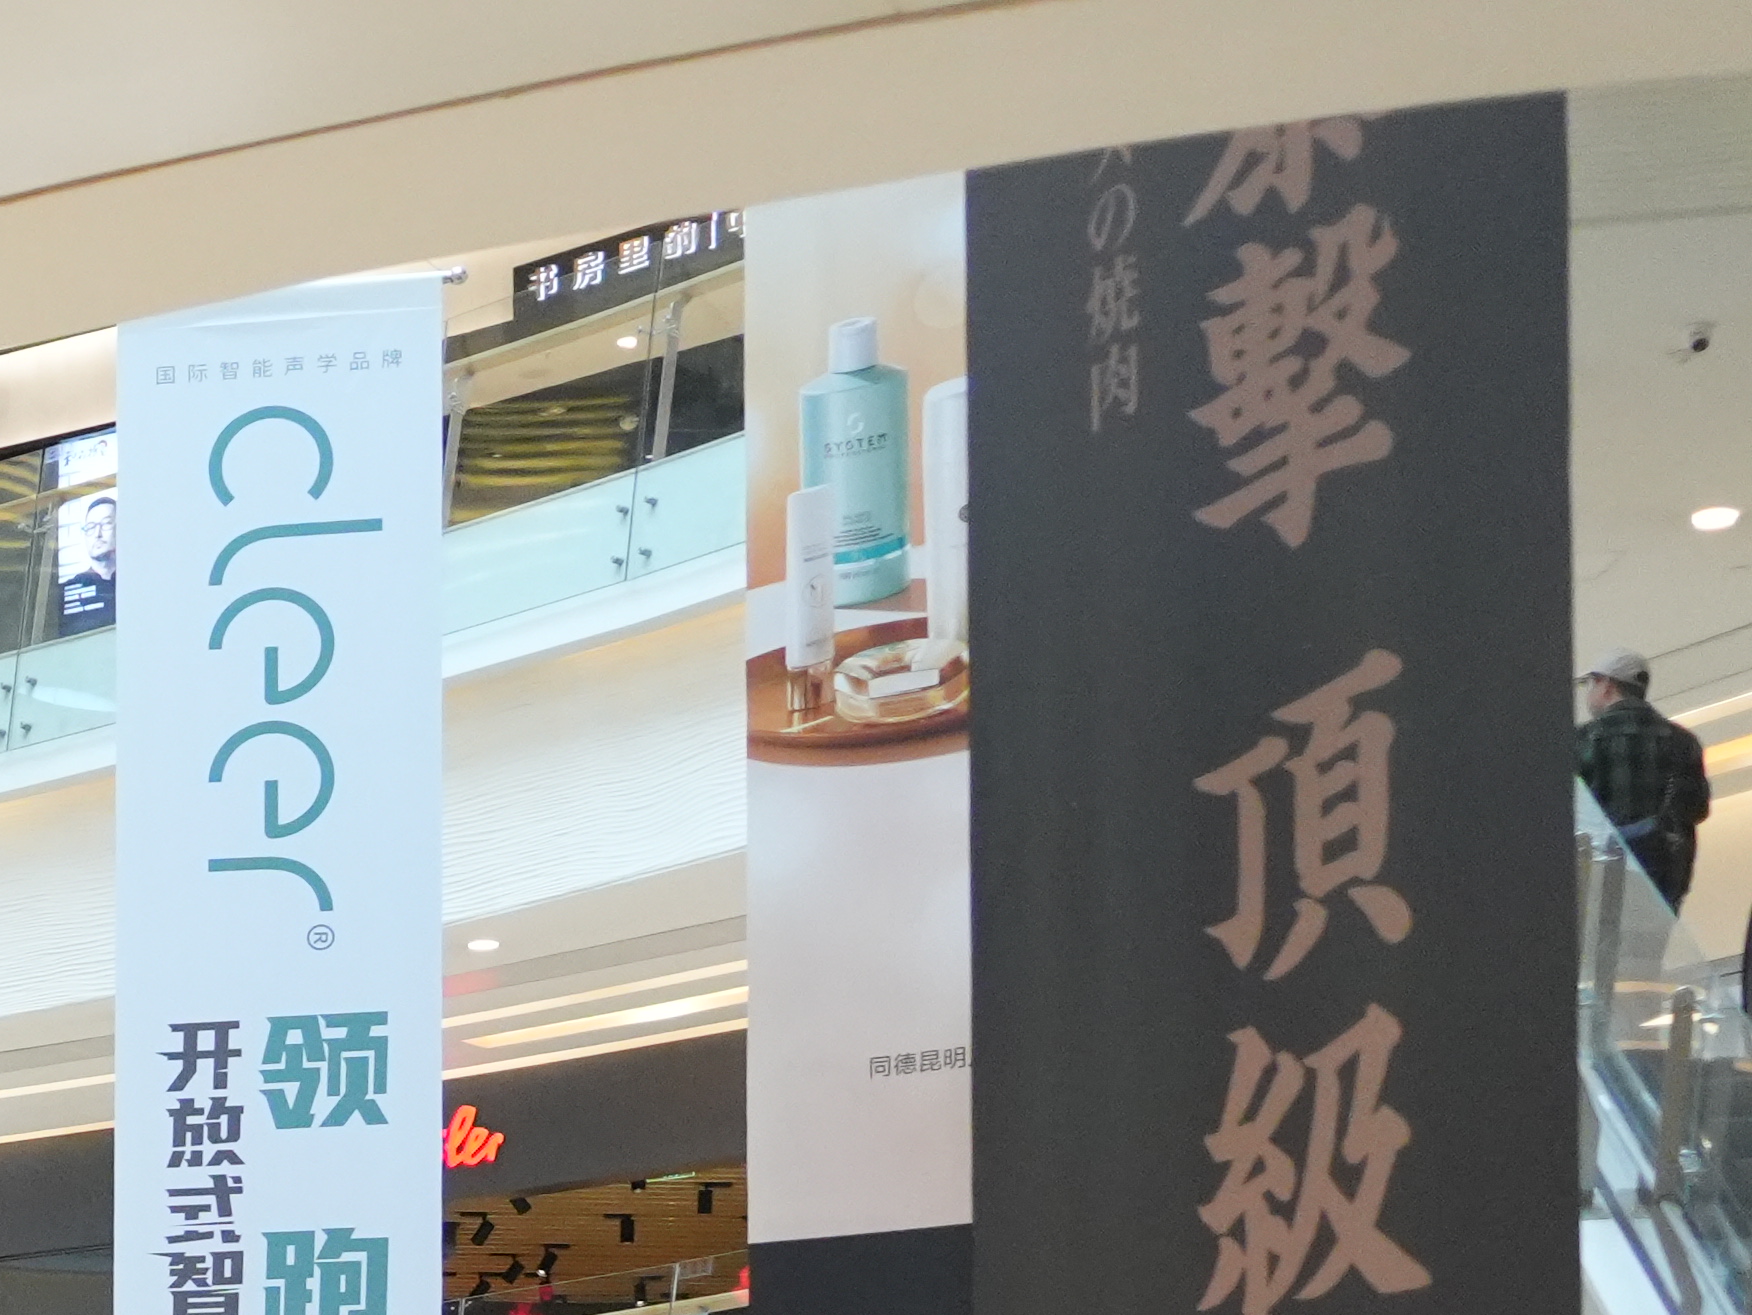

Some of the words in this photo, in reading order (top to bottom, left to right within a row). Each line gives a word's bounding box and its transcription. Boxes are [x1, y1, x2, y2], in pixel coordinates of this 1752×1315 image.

[1087, 149, 1139, 432] の燒肉
[155, 349, 403, 386] 国际智能声学品牌
[869, 1046, 972, 1079] 同德昆明
